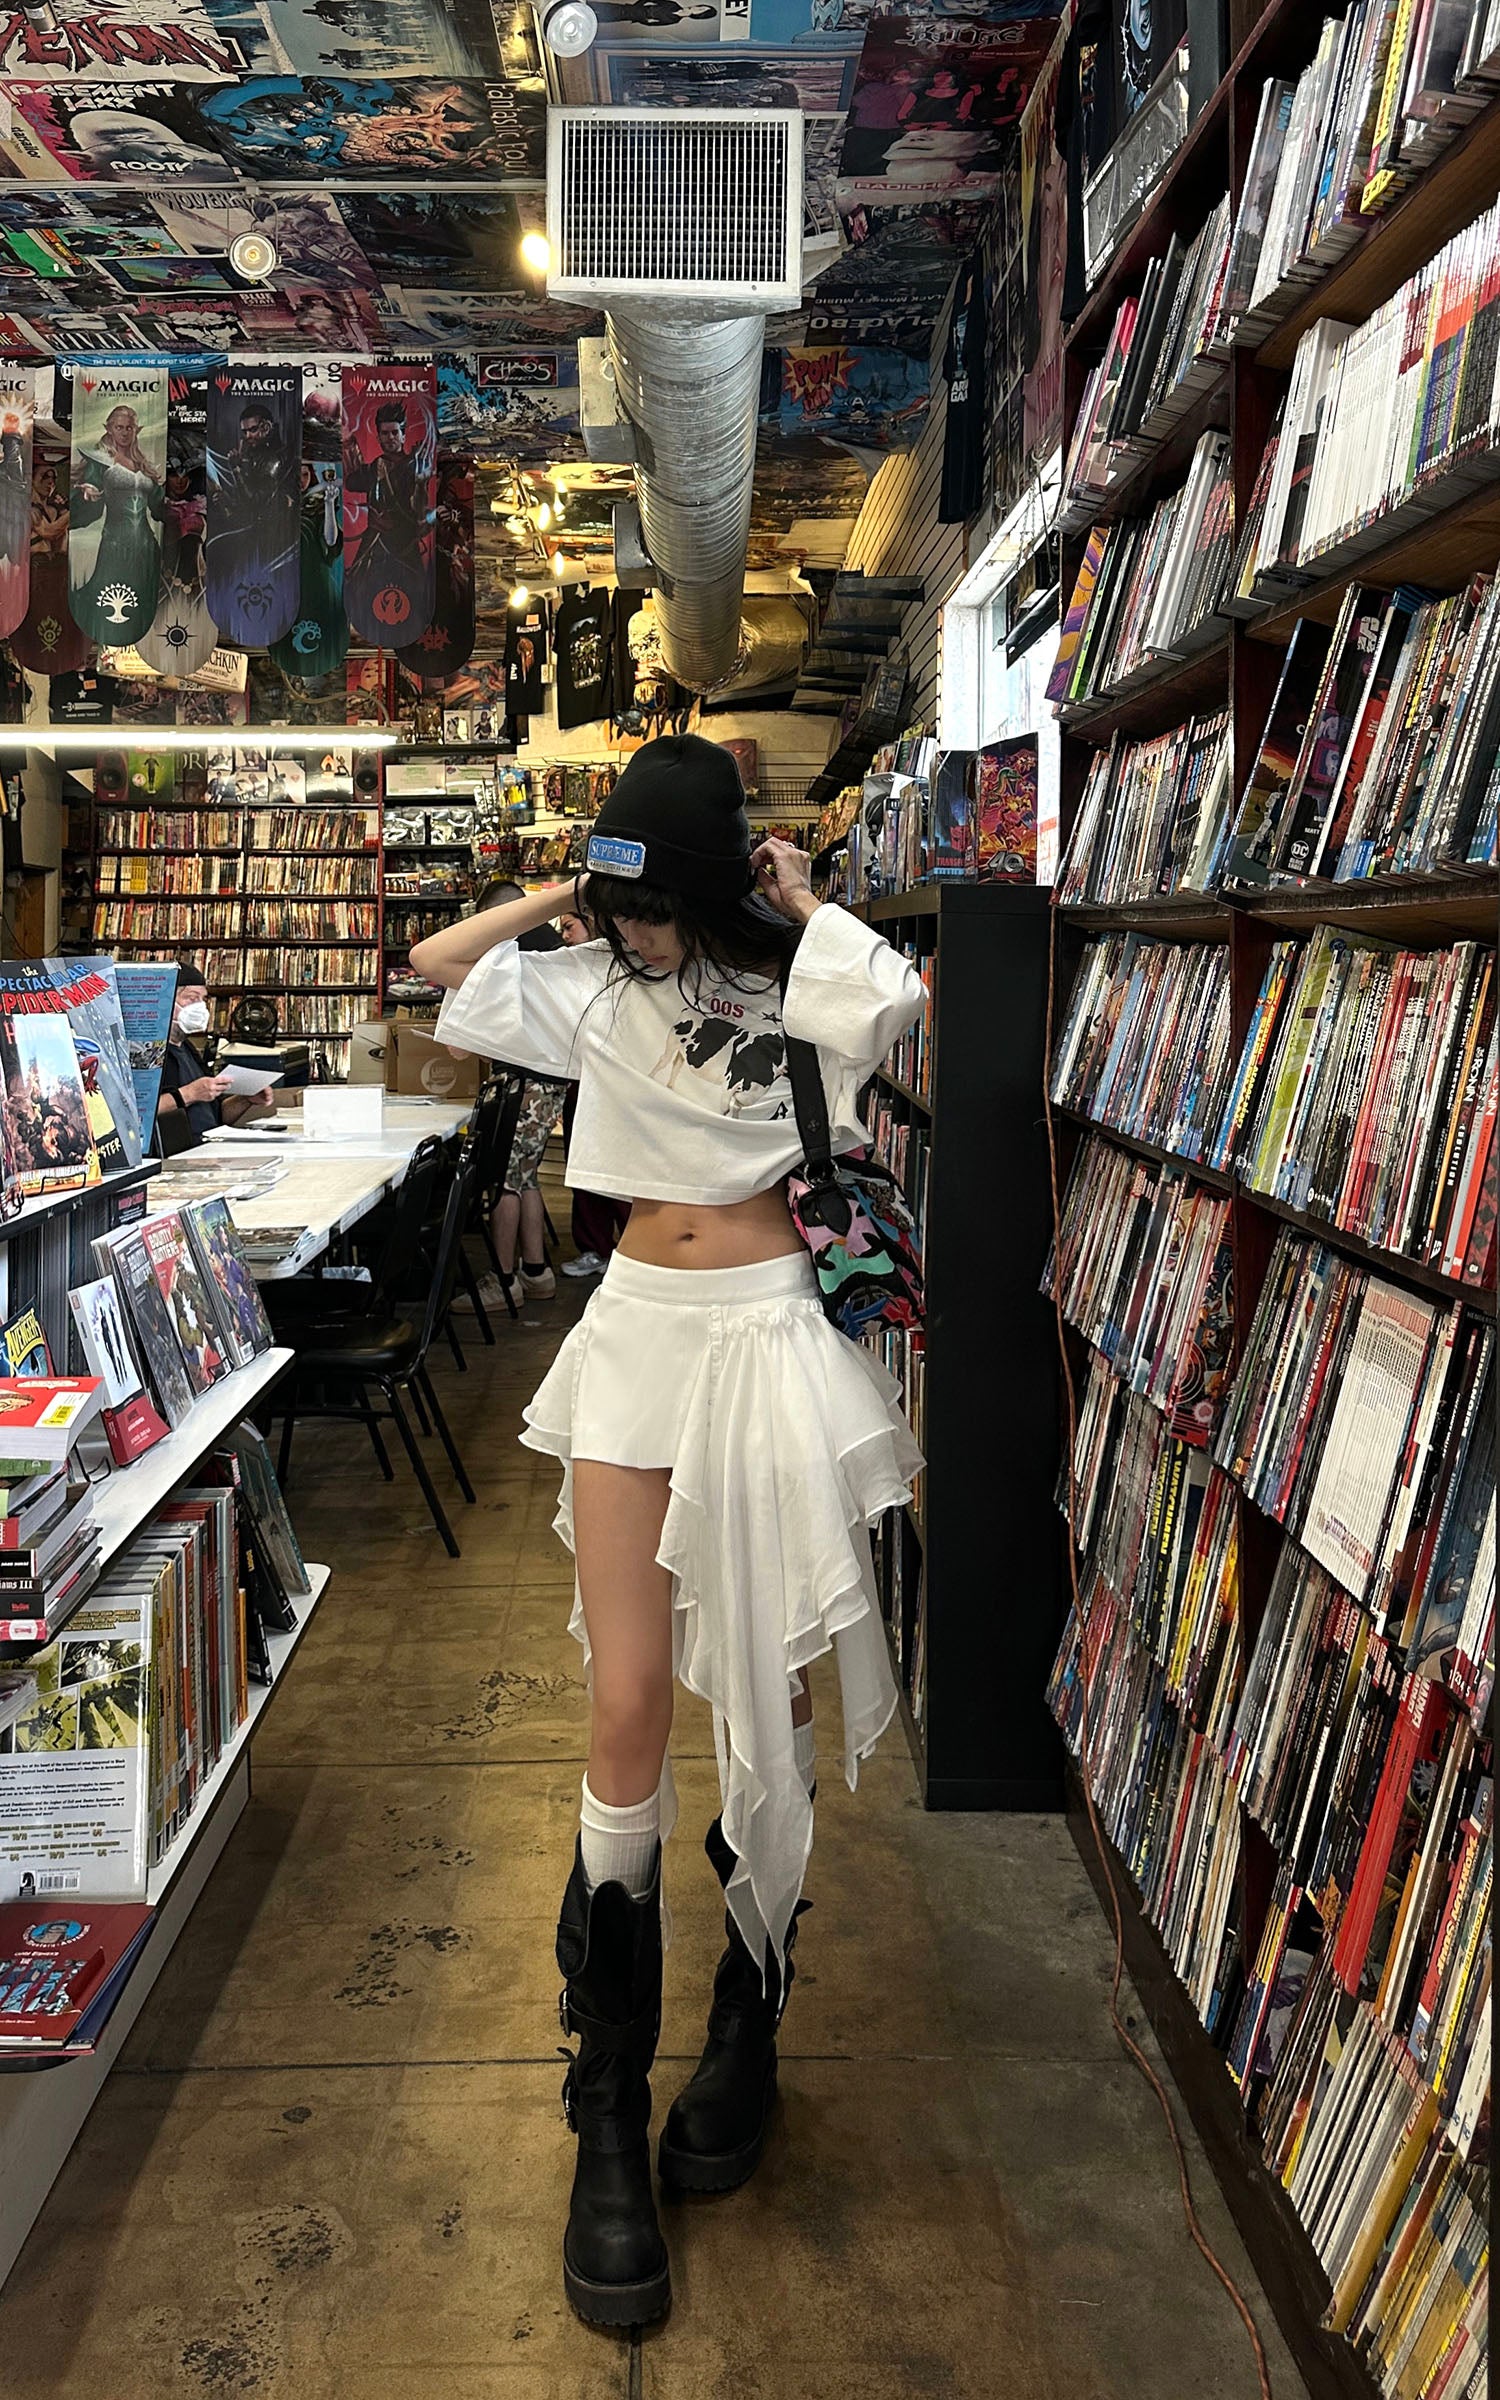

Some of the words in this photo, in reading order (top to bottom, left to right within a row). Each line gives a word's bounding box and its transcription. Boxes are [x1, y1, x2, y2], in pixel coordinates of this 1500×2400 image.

[10, 83, 176, 98] BASEMENT
[66, 96, 136, 112] JAXX
[483, 81, 521, 139] Fantastic
[496, 142, 530, 175] Four
[109, 160, 191, 173] ROOTY
[855, 177, 980, 191] RADIOHEAD
[809, 315, 938, 330] PLACEBO
[484, 360, 551, 381] CHAOS
[97, 380, 160, 393] MAGIC
[231, 378, 295, 392] MAGIC
[367, 378, 430, 393] MAGIC
[589, 839, 640, 865] SUPREME
[21, 964, 38, 978] the
[1462, 1055, 1483, 1103] RONIN
[1158, 1459, 1183, 1555] WATCHMEN
